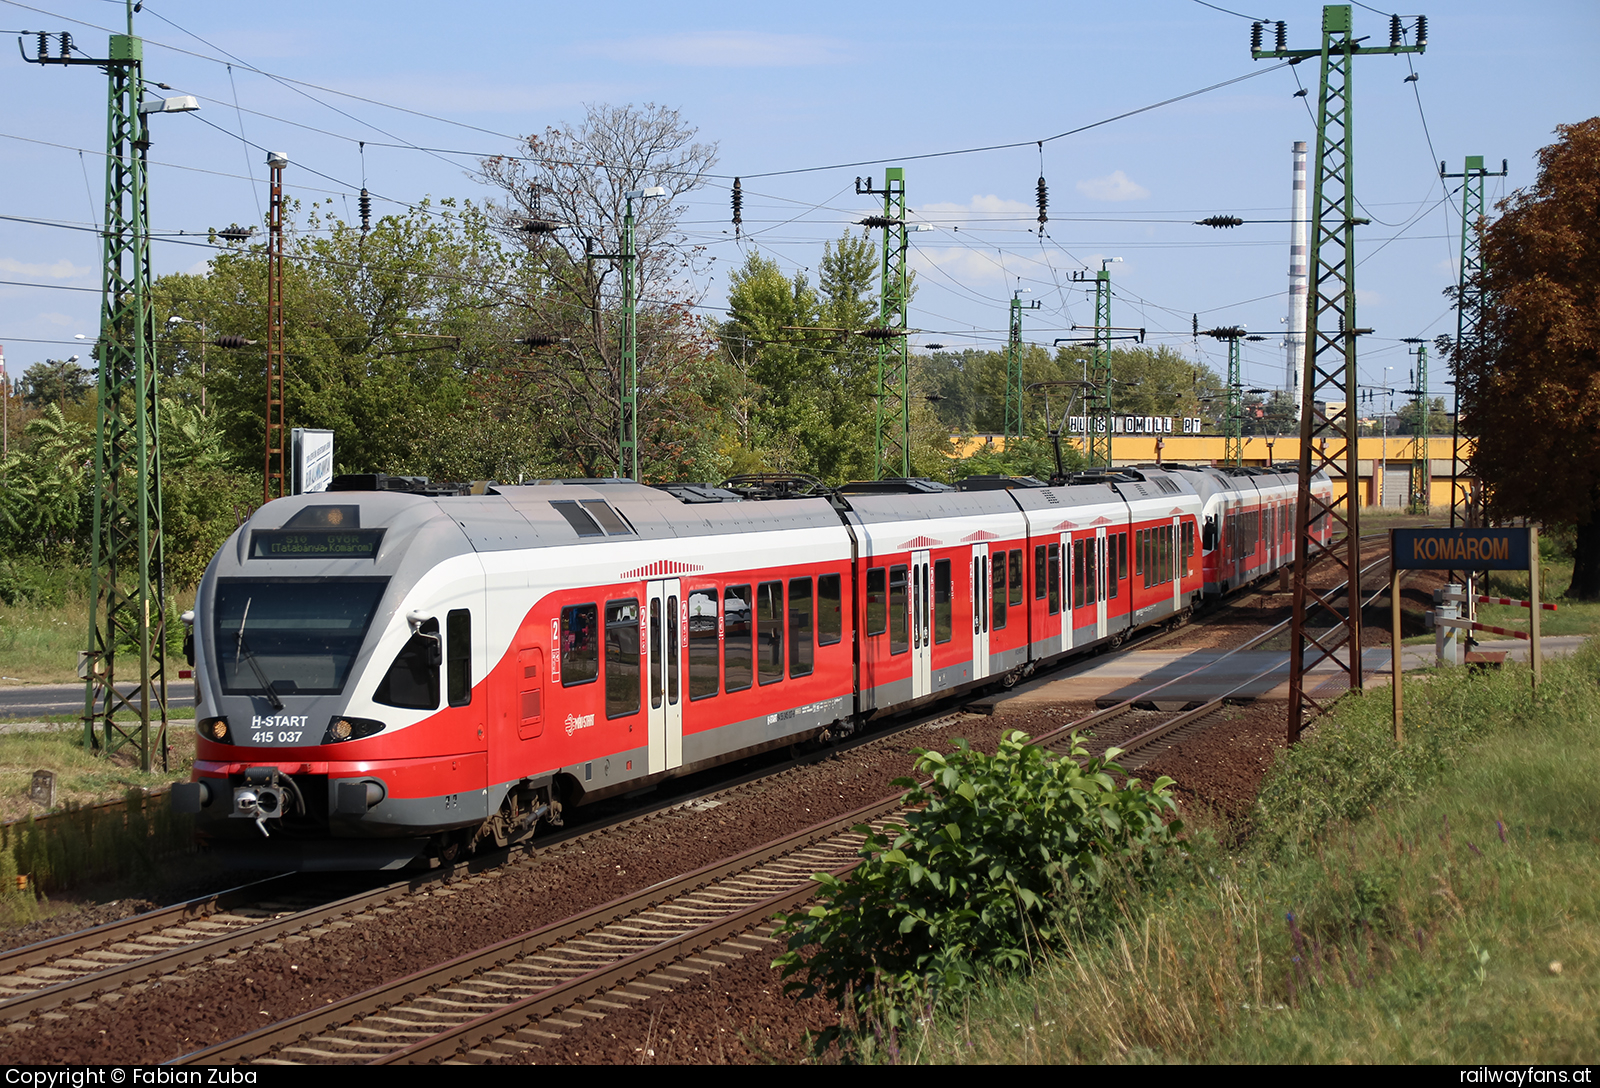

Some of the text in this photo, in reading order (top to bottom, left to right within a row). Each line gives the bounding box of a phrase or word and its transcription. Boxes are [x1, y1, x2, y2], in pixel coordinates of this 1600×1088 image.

[285, 535, 308, 544] S10
[1413, 532, 1509, 560] KOMÁROM
[250, 715, 309, 729] H-START
[252, 731, 303, 743] 415 037
